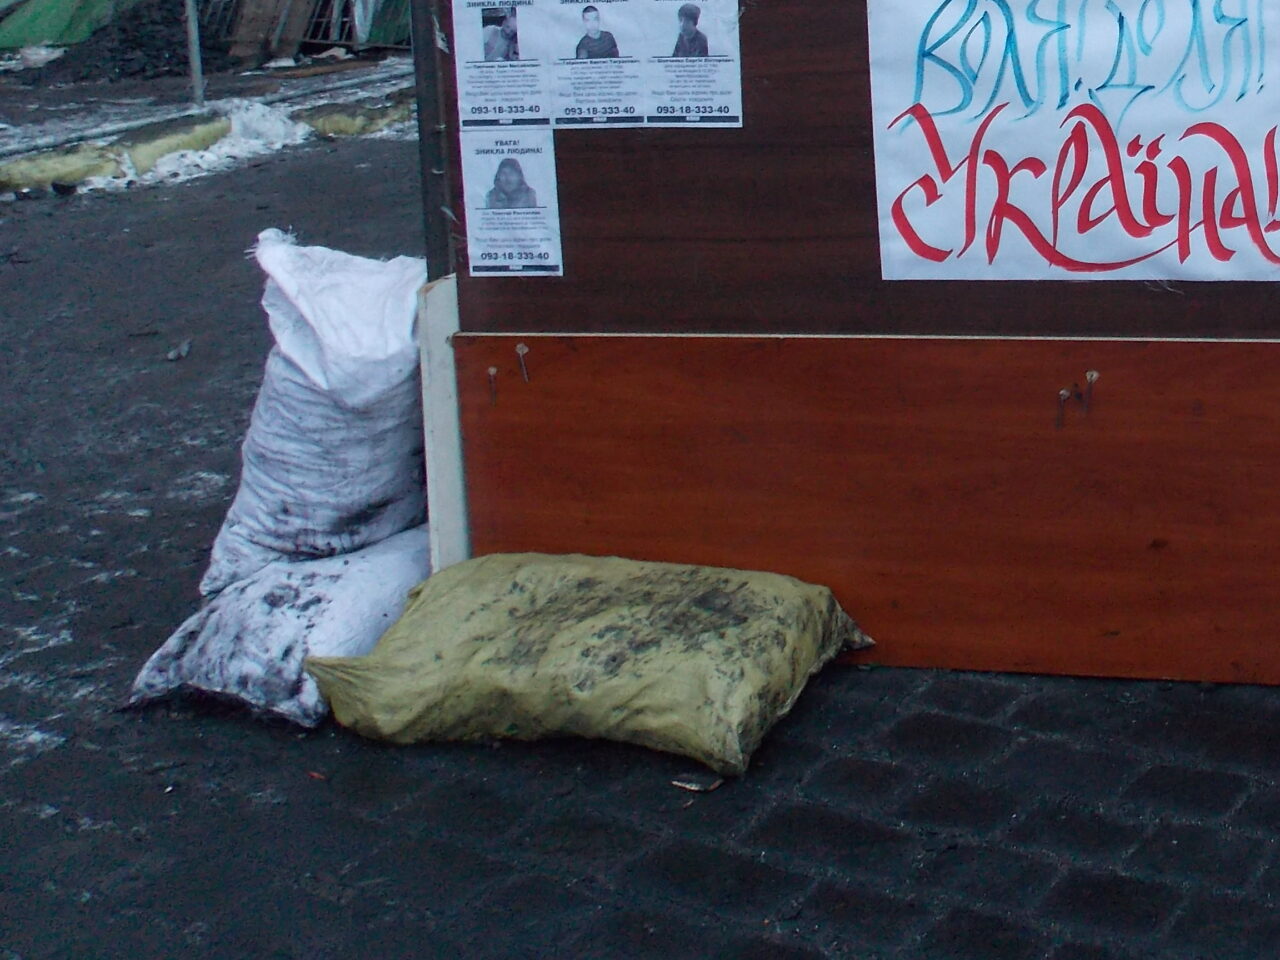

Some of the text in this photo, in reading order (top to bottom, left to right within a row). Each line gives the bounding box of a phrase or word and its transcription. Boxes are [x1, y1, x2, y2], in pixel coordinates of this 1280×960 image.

[471, 105, 541, 115] 093-18-333-40
[564, 106, 636, 116] 093-18-333-40
[656, 105, 730, 115] 093-18-333-40
[480, 251, 550, 260] 093-18-333-40
